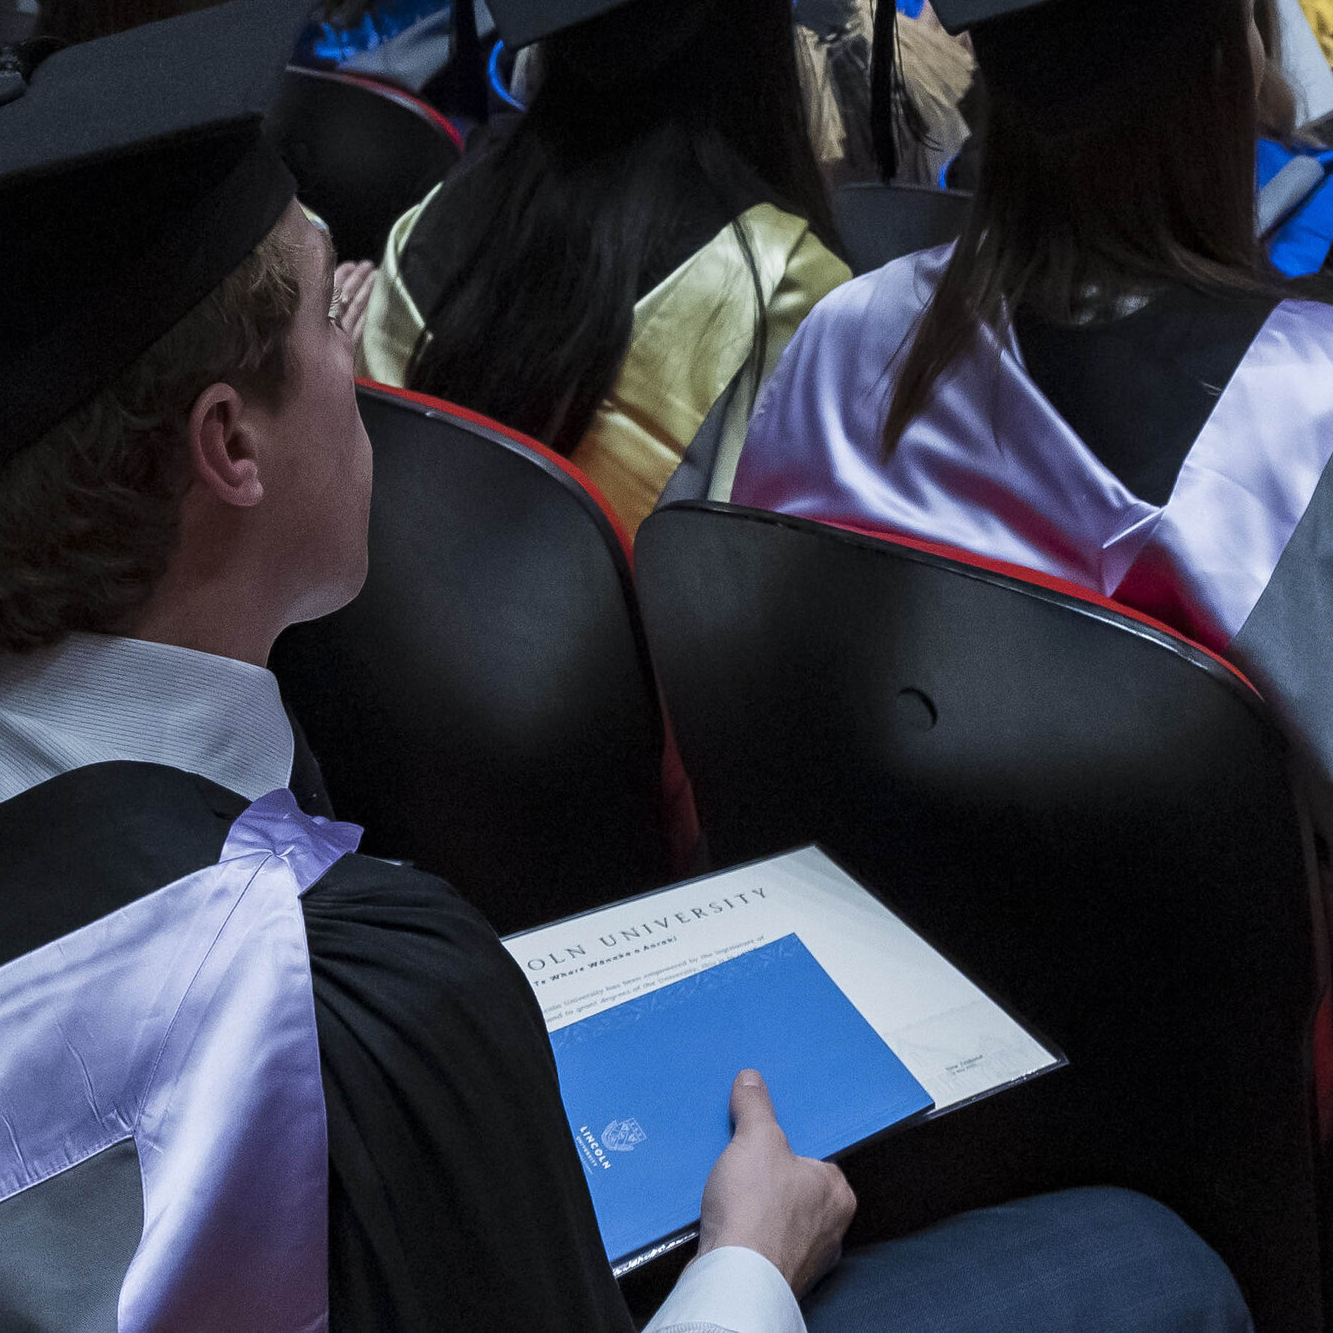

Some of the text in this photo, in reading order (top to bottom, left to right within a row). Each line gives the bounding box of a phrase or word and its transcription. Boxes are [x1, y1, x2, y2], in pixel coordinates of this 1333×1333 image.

[527, 888, 767, 971] OLN UNIVERSITY
[580, 1126, 612, 1169] LINCOLN
